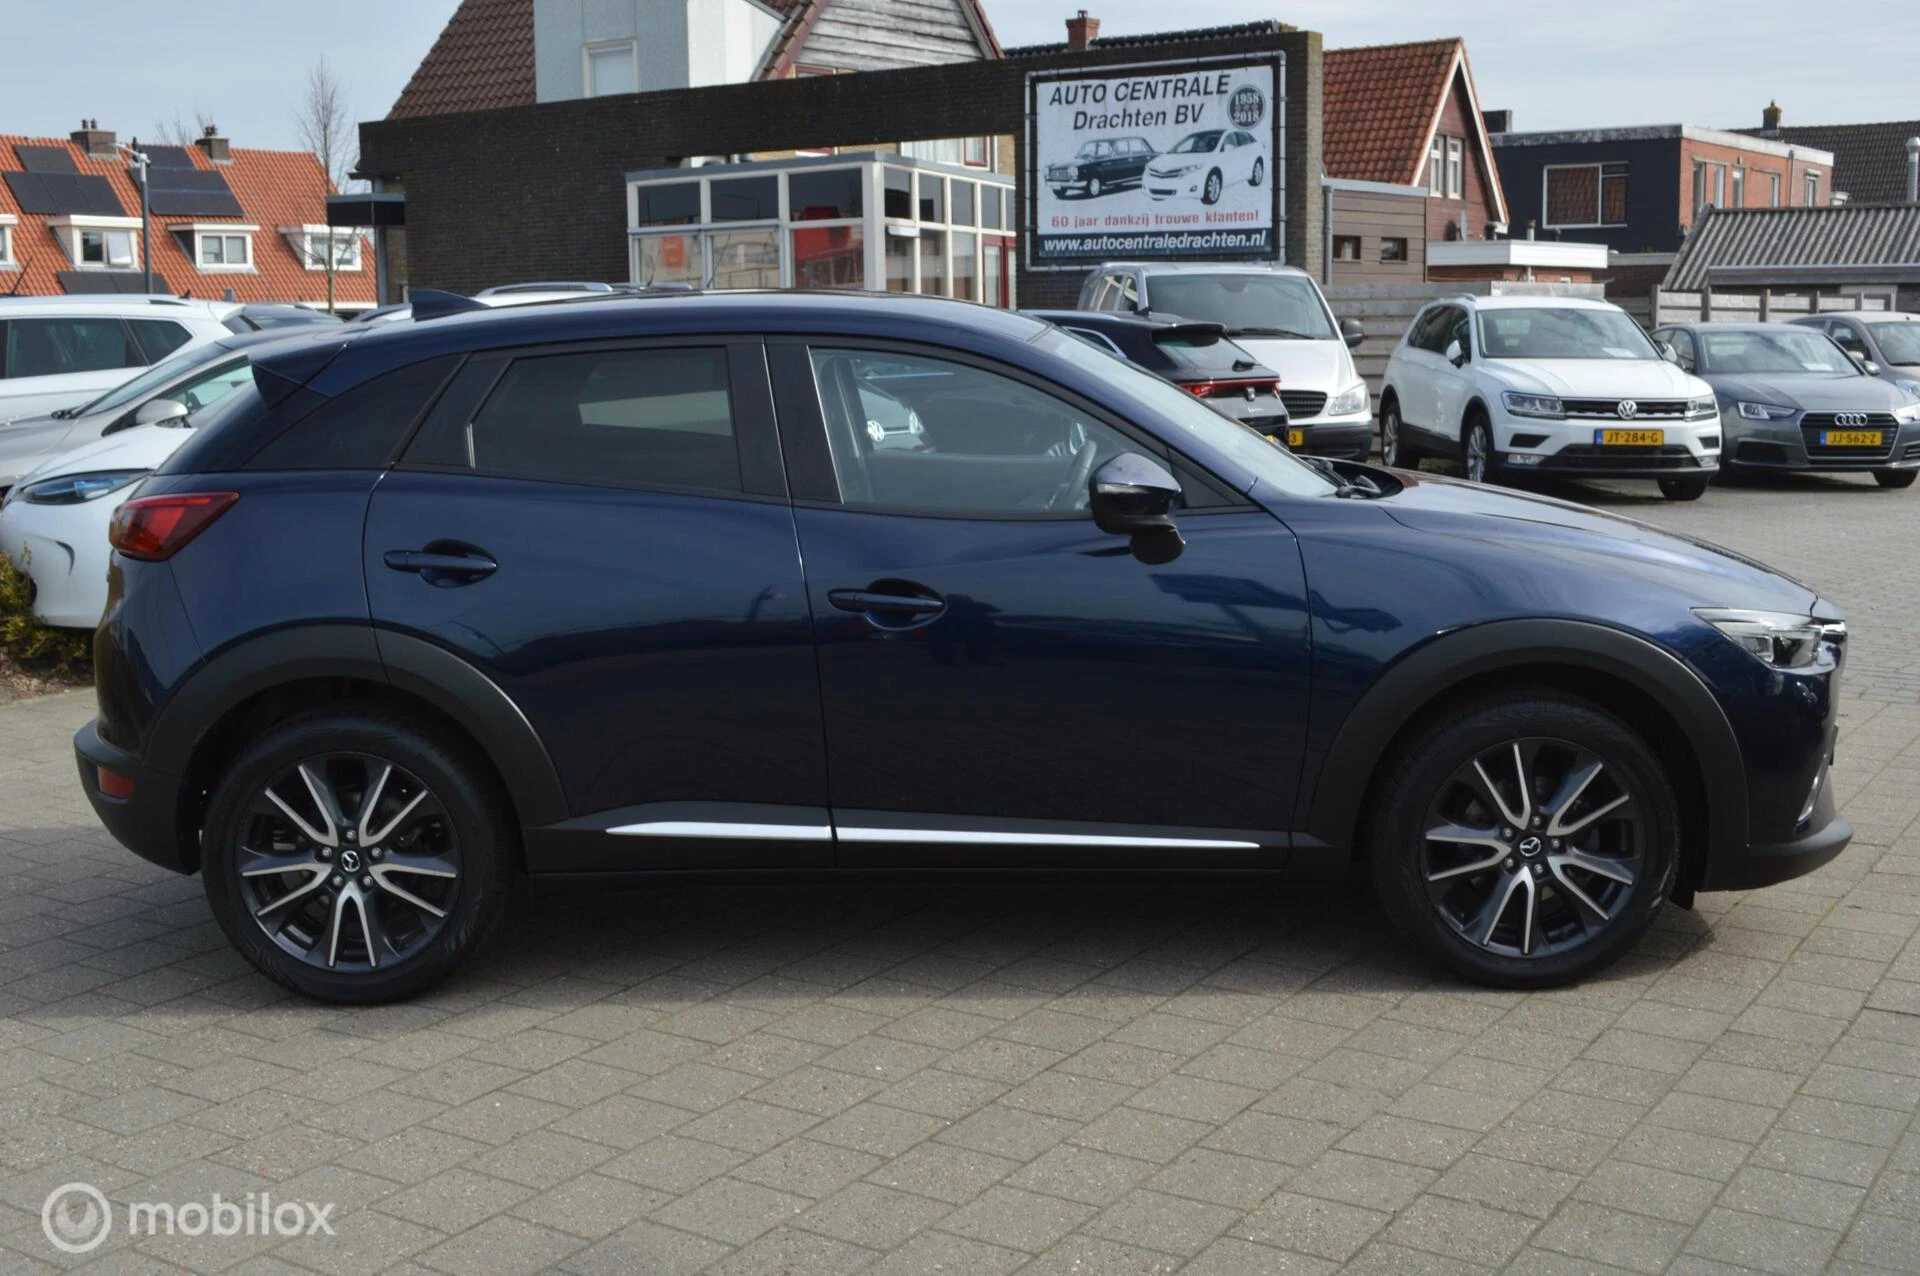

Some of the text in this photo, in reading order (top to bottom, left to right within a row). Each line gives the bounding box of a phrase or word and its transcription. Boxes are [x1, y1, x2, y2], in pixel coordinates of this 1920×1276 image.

[1050, 75, 1230, 106] AUTO CENTRALE
[1234, 91, 1260, 105] 1958
[1073, 103, 1204, 130] Drachten BV
[1233, 110, 1260, 123] 2018
[1051, 208, 1260, 228] 60 jaar dankzij trouwe klanten!
[1044, 230, 1266, 250] www.autocentraledrachten.nl
[1607, 431, 1659, 443] JT-284-G
[1831, 433, 1877, 444] JJ-562-Z
